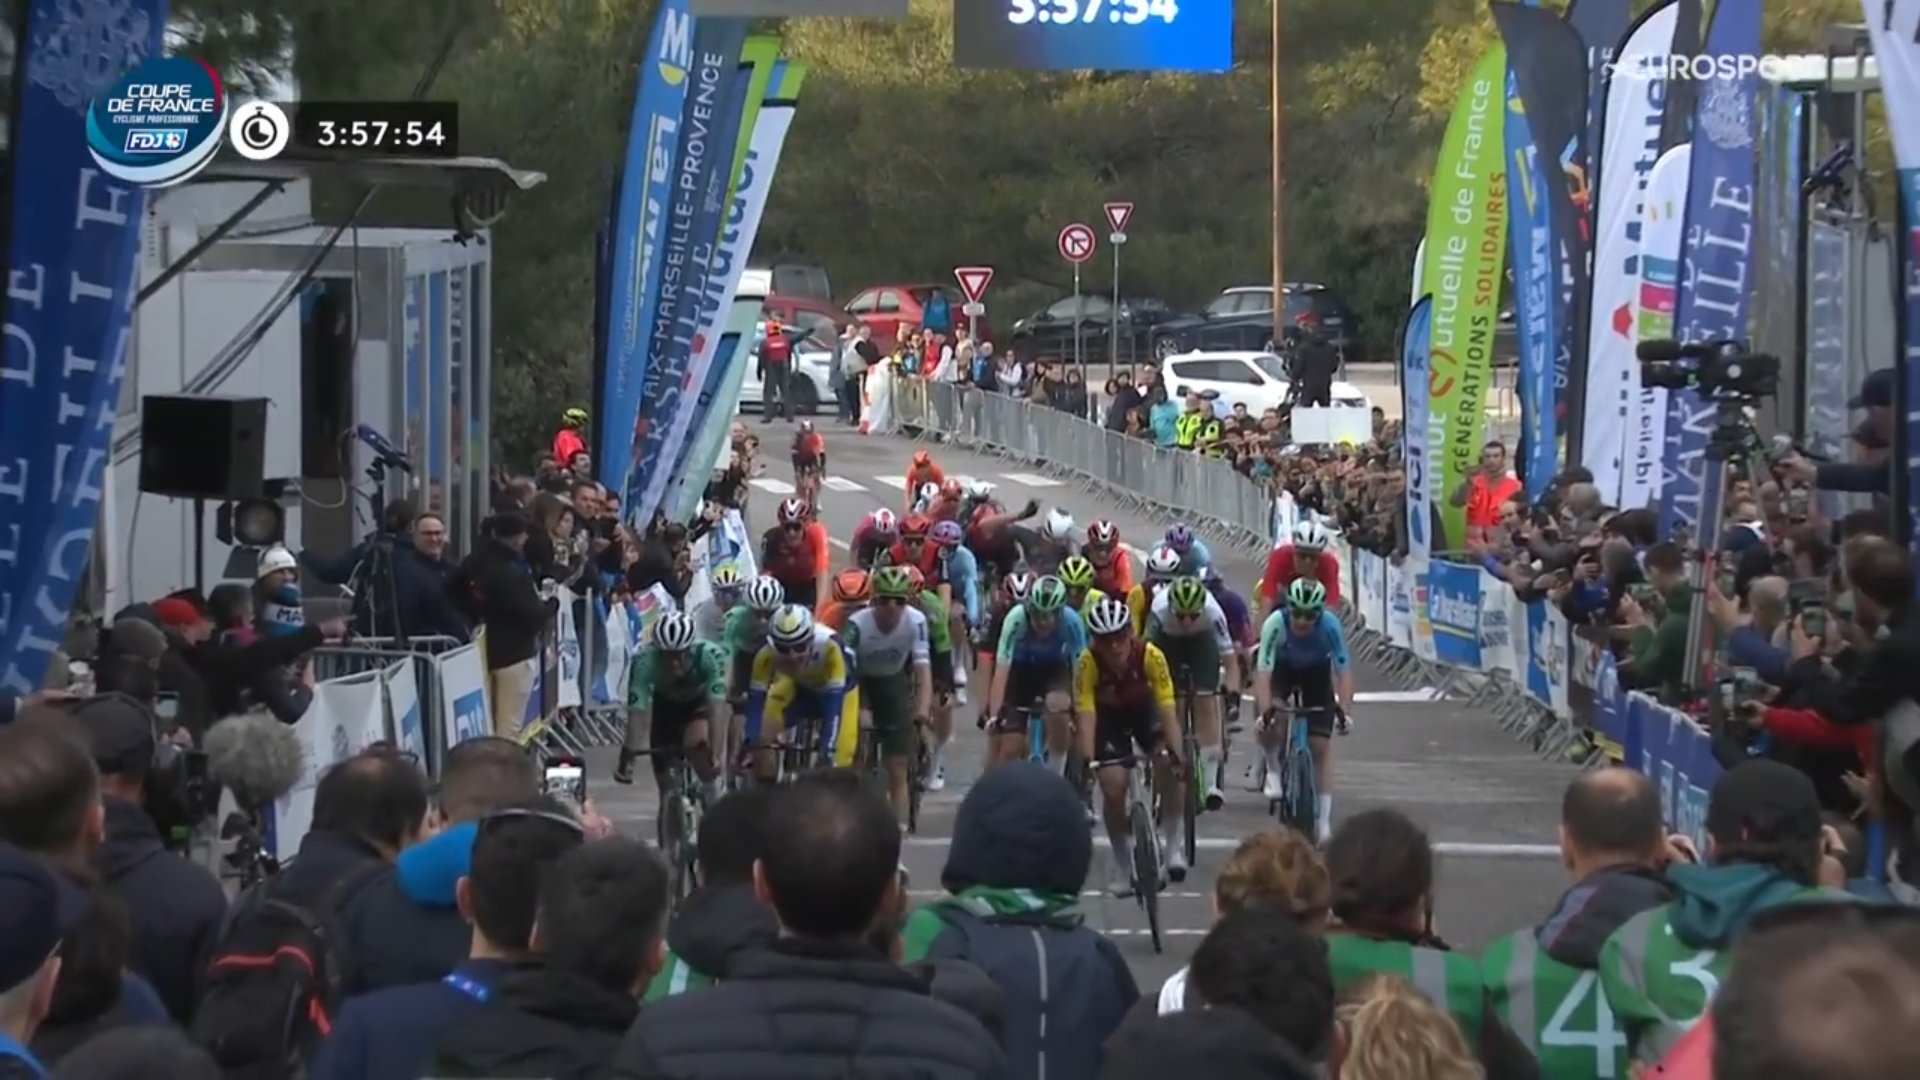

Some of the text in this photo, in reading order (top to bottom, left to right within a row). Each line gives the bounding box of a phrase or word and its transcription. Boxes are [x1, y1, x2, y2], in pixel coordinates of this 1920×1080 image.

[1456, 79, 1491, 179] France
[1452, 187, 1475, 225] de
[1453, 171, 1507, 475] GÉNÉRATIONS SOLIDAIRES
[1541, 969, 1628, 1079] 4
